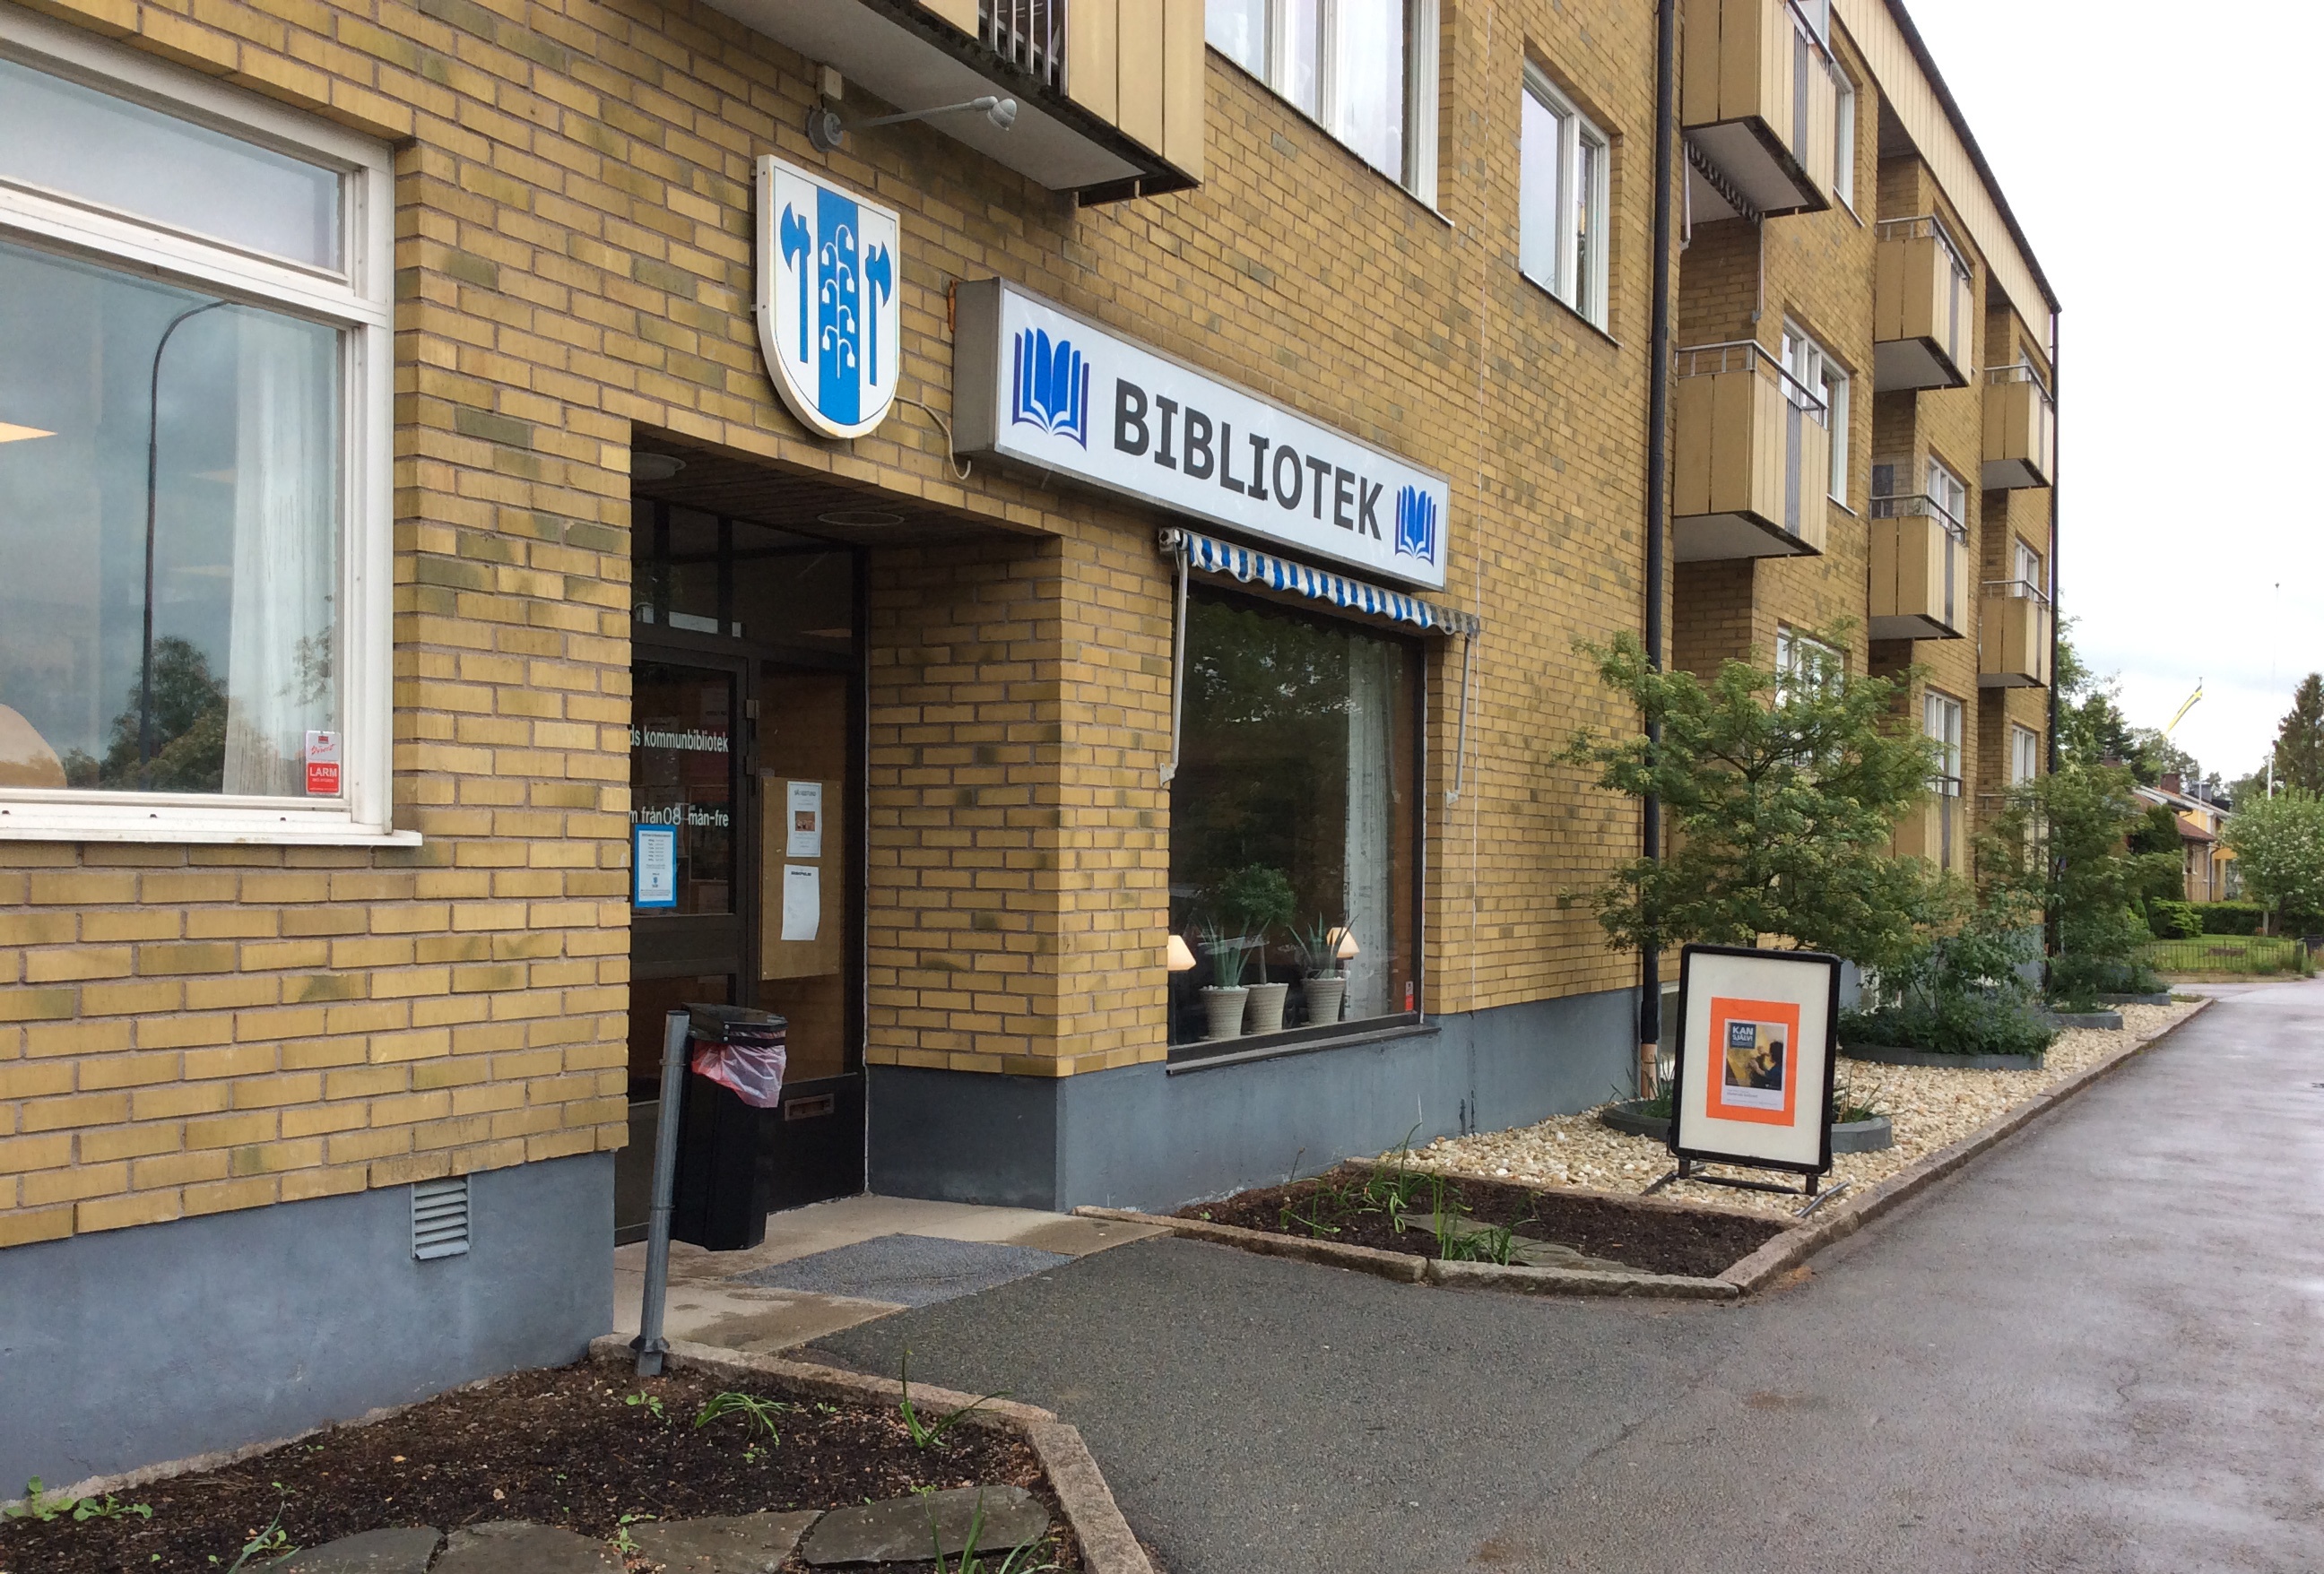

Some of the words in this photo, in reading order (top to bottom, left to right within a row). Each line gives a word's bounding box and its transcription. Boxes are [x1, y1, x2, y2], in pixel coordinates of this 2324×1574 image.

[1114, 377, 1383, 541] BIBLIOTEK
[644, 726, 729, 752] kommunbibliotek
[309, 767, 337, 777] LARM
[689, 809, 729, 826] mån-fre
[1732, 1026, 1754, 1035] KAN
